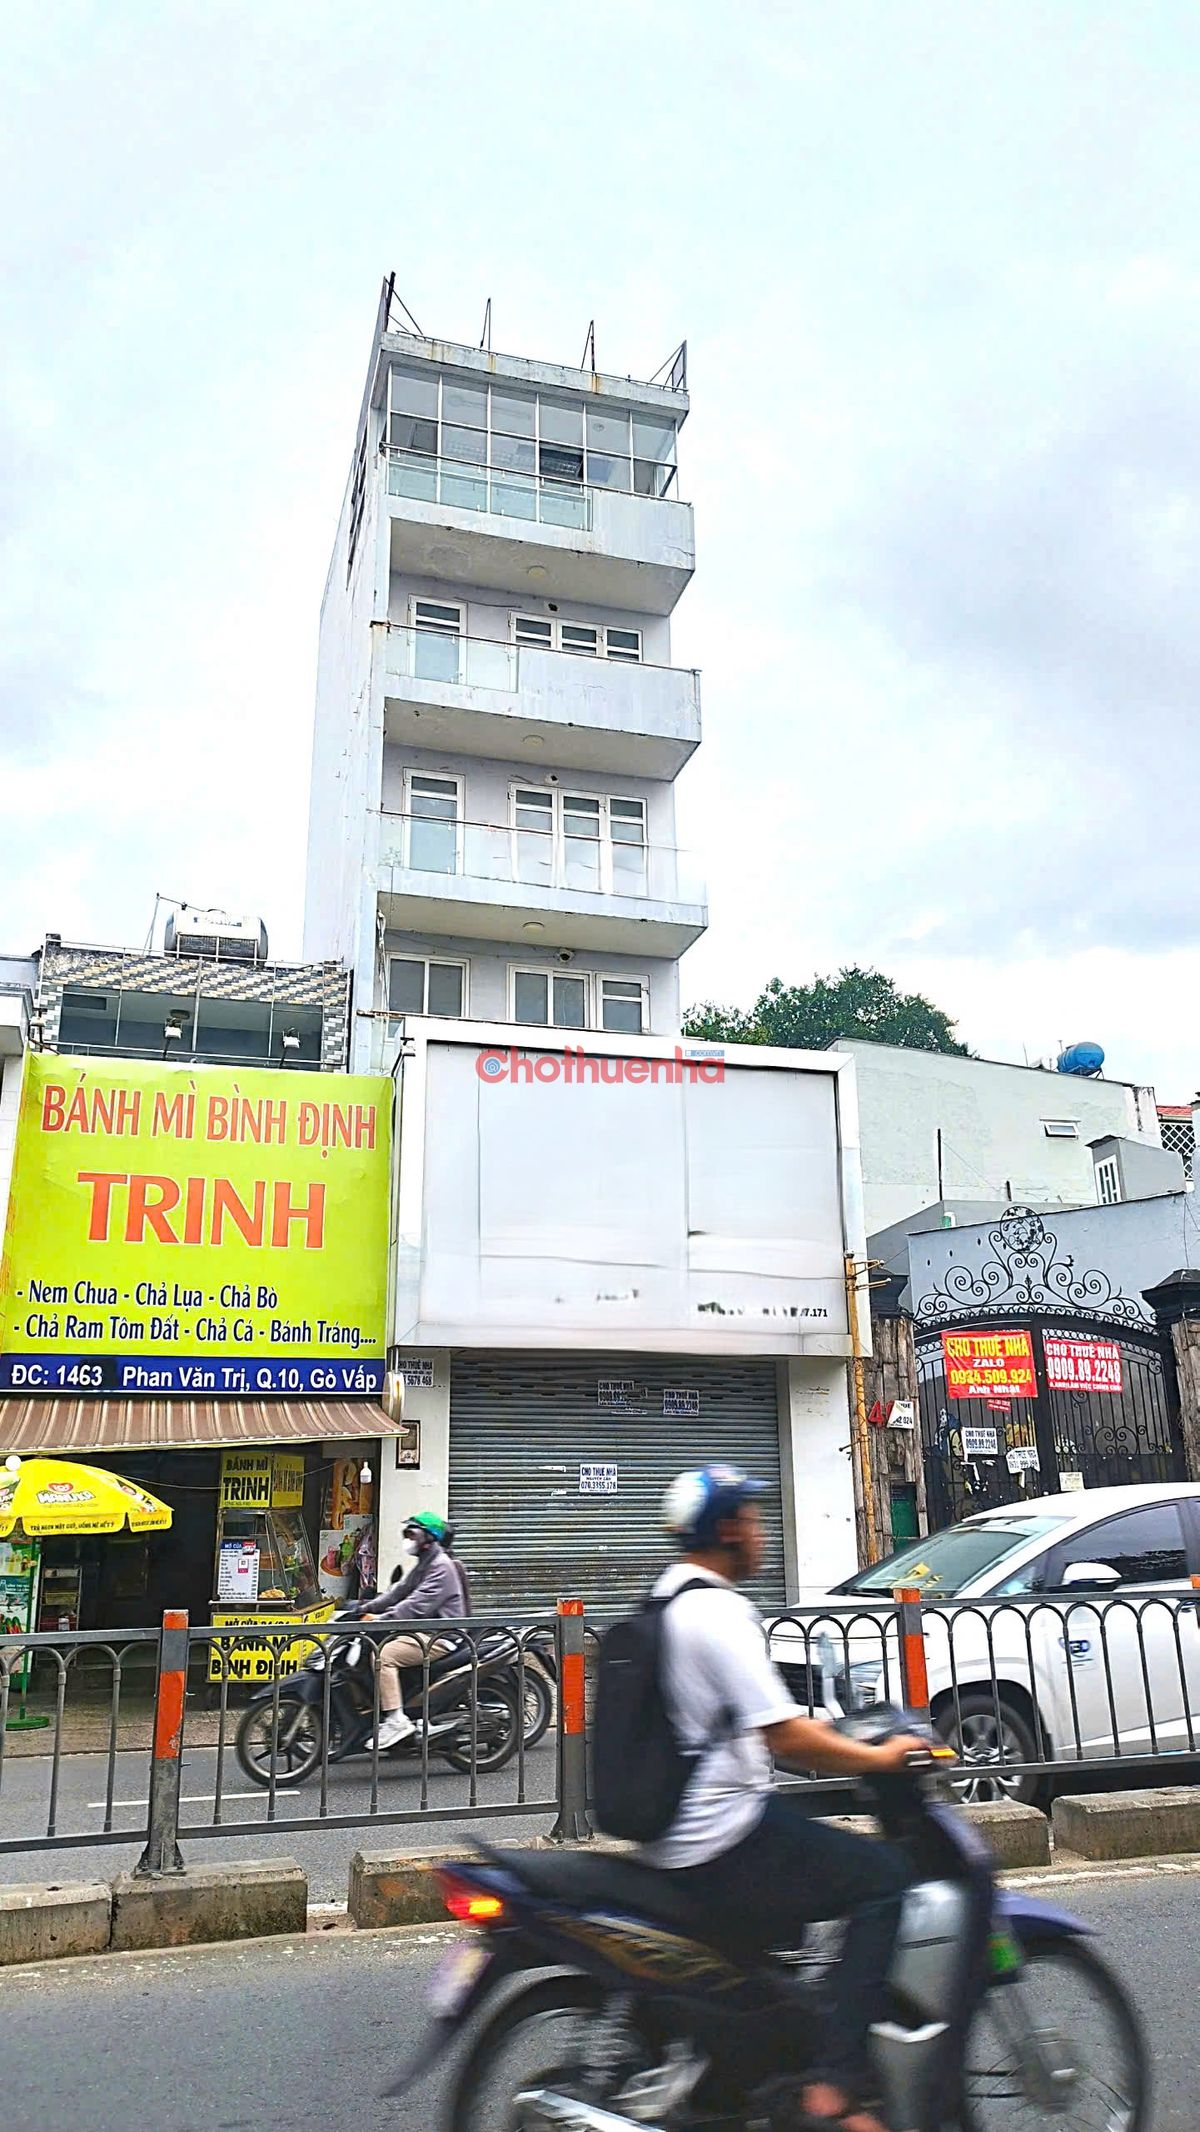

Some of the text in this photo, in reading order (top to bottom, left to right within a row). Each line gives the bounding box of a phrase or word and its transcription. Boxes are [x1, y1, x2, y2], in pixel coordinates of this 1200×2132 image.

[42, 1073, 376, 1158] BÁNH MÌ BÌNH ĐỊNH
[77, 1171, 327, 1249] TRINH
[29, 1280, 68, 1303] Nem
[74, 1281, 117, 1304] Chua
[136, 1282, 167, 1306] Chả
[174, 1284, 202, 1312] Lụa
[220, 1284, 251, 1308] Chả
[257, 1286, 278, 1309] Bò
[26, 1313, 59, 1338] Chả
[65, 1315, 104, 1339] Ram
[110, 1316, 144, 1340] Tôm
[150, 1314, 179, 1340] Đất
[196, 1317, 227, 1341] Chả
[233, 1319, 253, 1342] Cá
[270, 1320, 311, 1343] Bánh
[947, 1334, 1030, 1357] CHO THUÊ NHÀ
[1046, 1343, 1119, 1359] CHO THUÊ NHÀ
[972, 1359, 1004, 1368] ZALO
[1047, 1357, 1121, 1383] 0909.89.2248
[11, 1364, 377, 1391] ĐC: 1463 Phan Văn Trị, Q.10, Gò Vấp
[969, 1385, 990, 1394] Anh
[226, 1456, 254, 1470] BÁNH
[223, 1476, 270, 1501] TRINH
[211, 1660, 251, 1675] BNH
